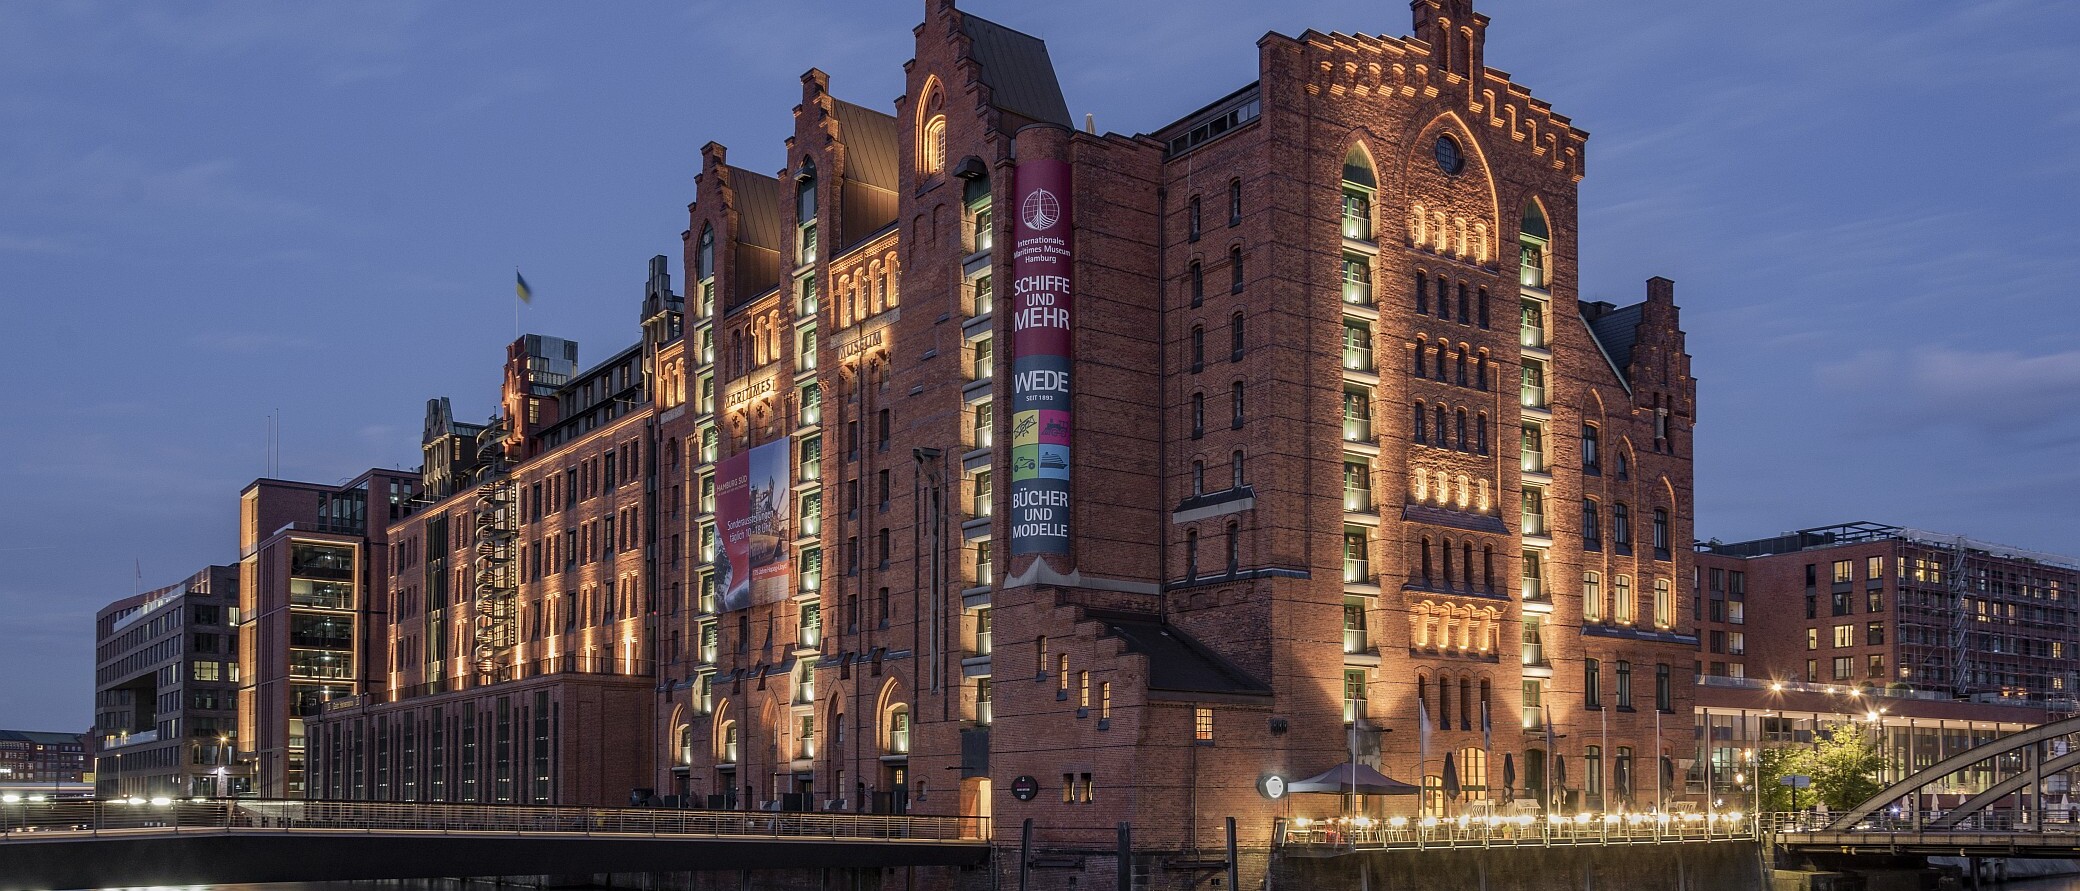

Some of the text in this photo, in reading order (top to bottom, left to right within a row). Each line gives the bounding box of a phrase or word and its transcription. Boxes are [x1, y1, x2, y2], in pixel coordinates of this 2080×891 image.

[1018, 236, 1065, 248] Internationales
[1013, 245, 1071, 259] Maritimes Museum
[1025, 254, 1057, 264] Hamburg
[1014, 275, 1070, 296] SCHIFFE
[1026, 293, 1055, 307] UND
[1014, 306, 1070, 332] MEHR
[838, 330, 882, 361] MUSEUM
[1014, 370, 1069, 393] WEDE
[725, 379, 771, 409] MARITIMES
[716, 478, 738, 493] HAMBURG
[738, 474, 748, 485] SÜD
[1013, 487, 1068, 508] BÜCHER
[727, 510, 774, 531] Sonderausstellungen
[1024, 508, 1053, 522] UND
[729, 530, 745, 544] täglich
[1012, 523, 1068, 539] MODELLE
